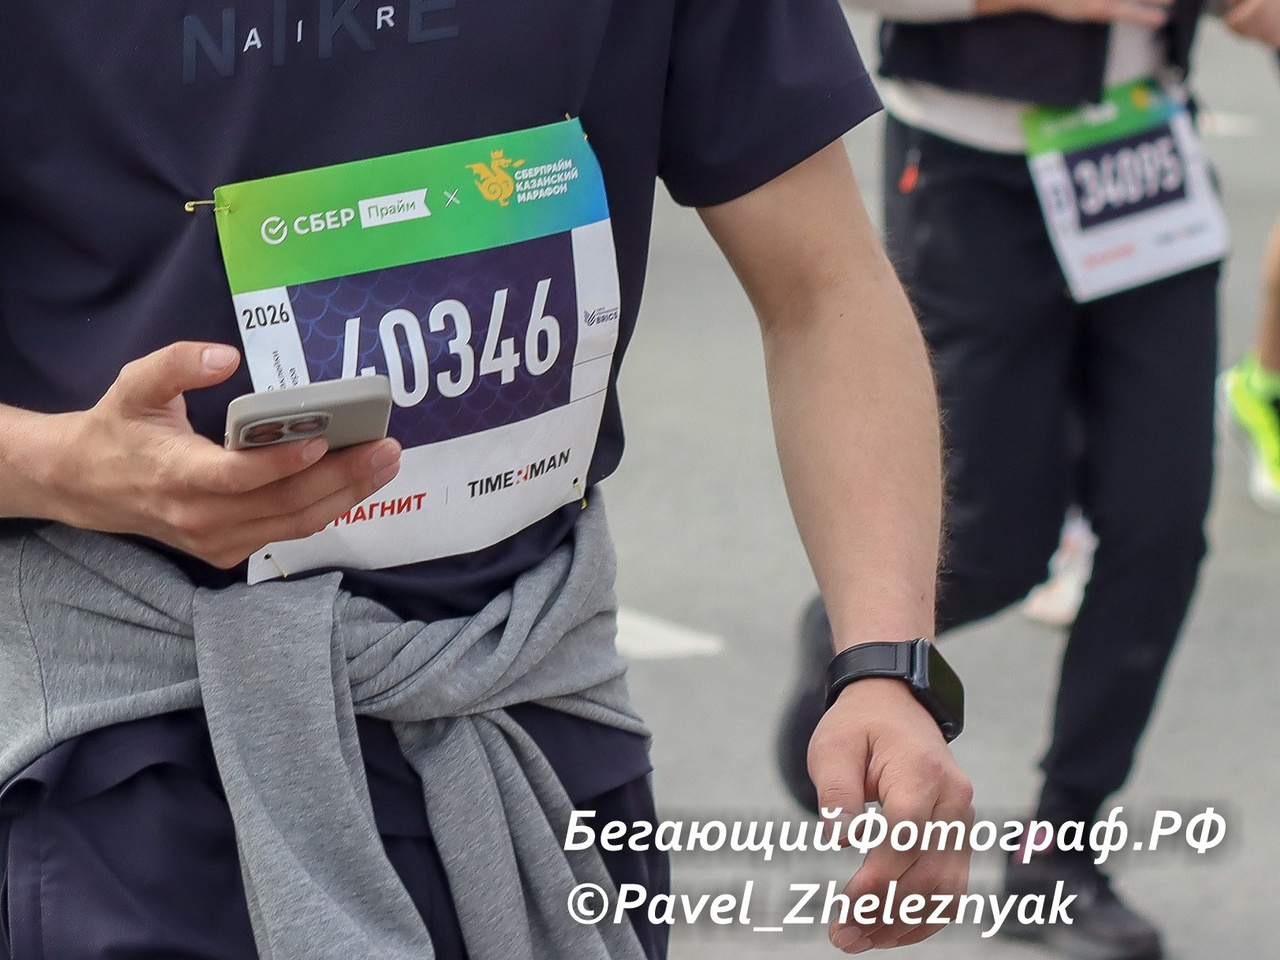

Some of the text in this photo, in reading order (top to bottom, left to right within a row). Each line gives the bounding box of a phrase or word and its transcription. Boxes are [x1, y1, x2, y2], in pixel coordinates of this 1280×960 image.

[515, 158, 573, 180] СБЕРПРАЙМ
[516, 167, 578, 192] КАЗАНСКИЙ
[1074, 136, 1181, 215] 34095
[517, 183, 568, 203] МАРАФОН
[293, 200, 416, 235] СБЕР Прайм
[242, 303, 290, 330] 2026
